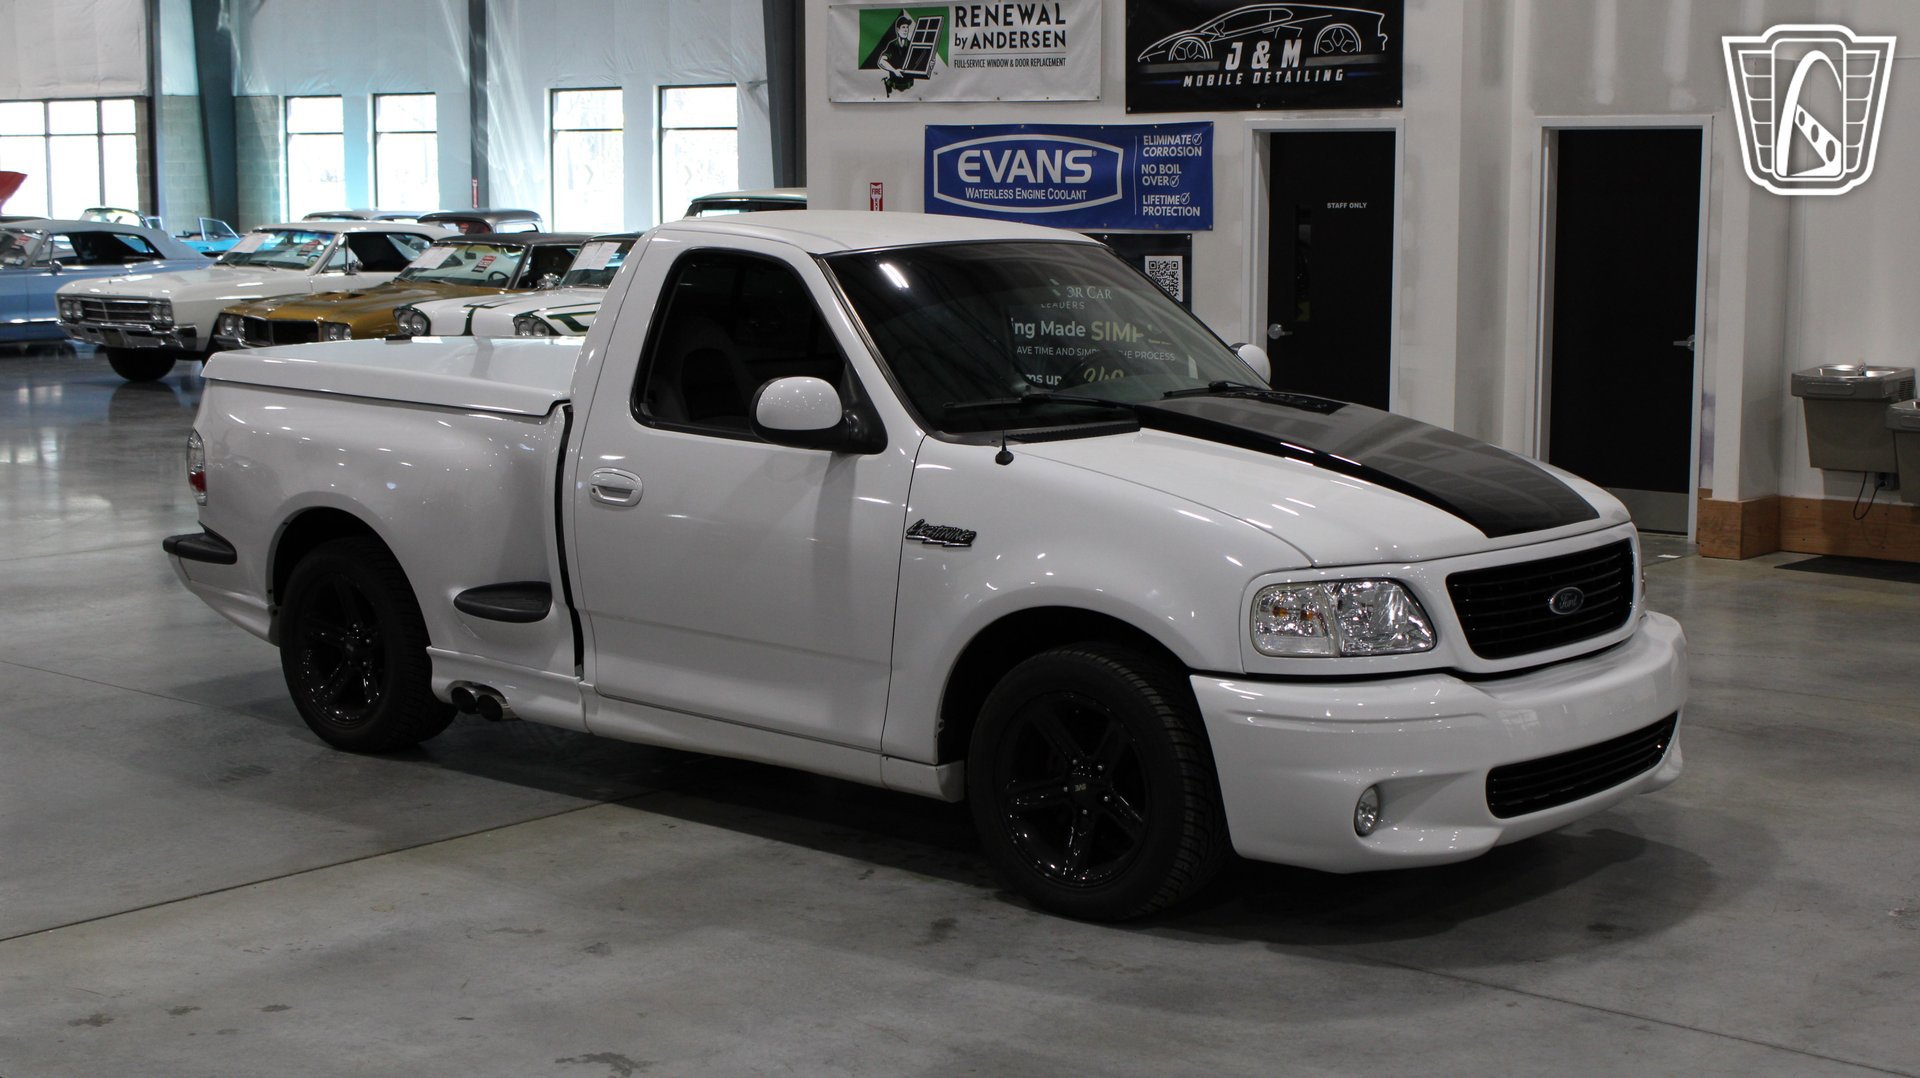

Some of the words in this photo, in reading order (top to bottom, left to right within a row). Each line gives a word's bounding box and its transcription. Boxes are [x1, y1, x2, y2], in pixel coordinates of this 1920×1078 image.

[955, 3, 1066, 27] RENEWAL
[954, 33, 967, 50] by
[970, 30, 1066, 49] ANDERSEN
[1225, 42, 1243, 71] J
[1251, 40, 1271, 69] &
[1281, 39, 1302, 68] M
[987, 59, 1009, 68] WINDOW
[1015, 59, 1030, 67] DOOR
[1030, 57, 1066, 67] REPLACEMENT
[1183, 73, 1244, 87] MOBILE
[1252, 69, 1344, 84] DETAILING
[1143, 134, 1192, 145] ELIMINATE
[1142, 146, 1202, 157] CORROSION
[957, 149, 1093, 184] EVANS
[1141, 164, 1157, 174] NO
[1159, 164, 1182, 174] BOIL
[1142, 176, 1169, 186] OVER
[1143, 194, 1180, 205] LIFETIME
[1142, 206, 1200, 216] PROTECTION
[1040, 321, 1086, 337] Made
[1016, 346, 1032, 355] AVE
[1034, 346, 1054, 355] TIME
[1055, 347, 1075, 356] AND
[1134, 351, 1176, 361] PROCESS
